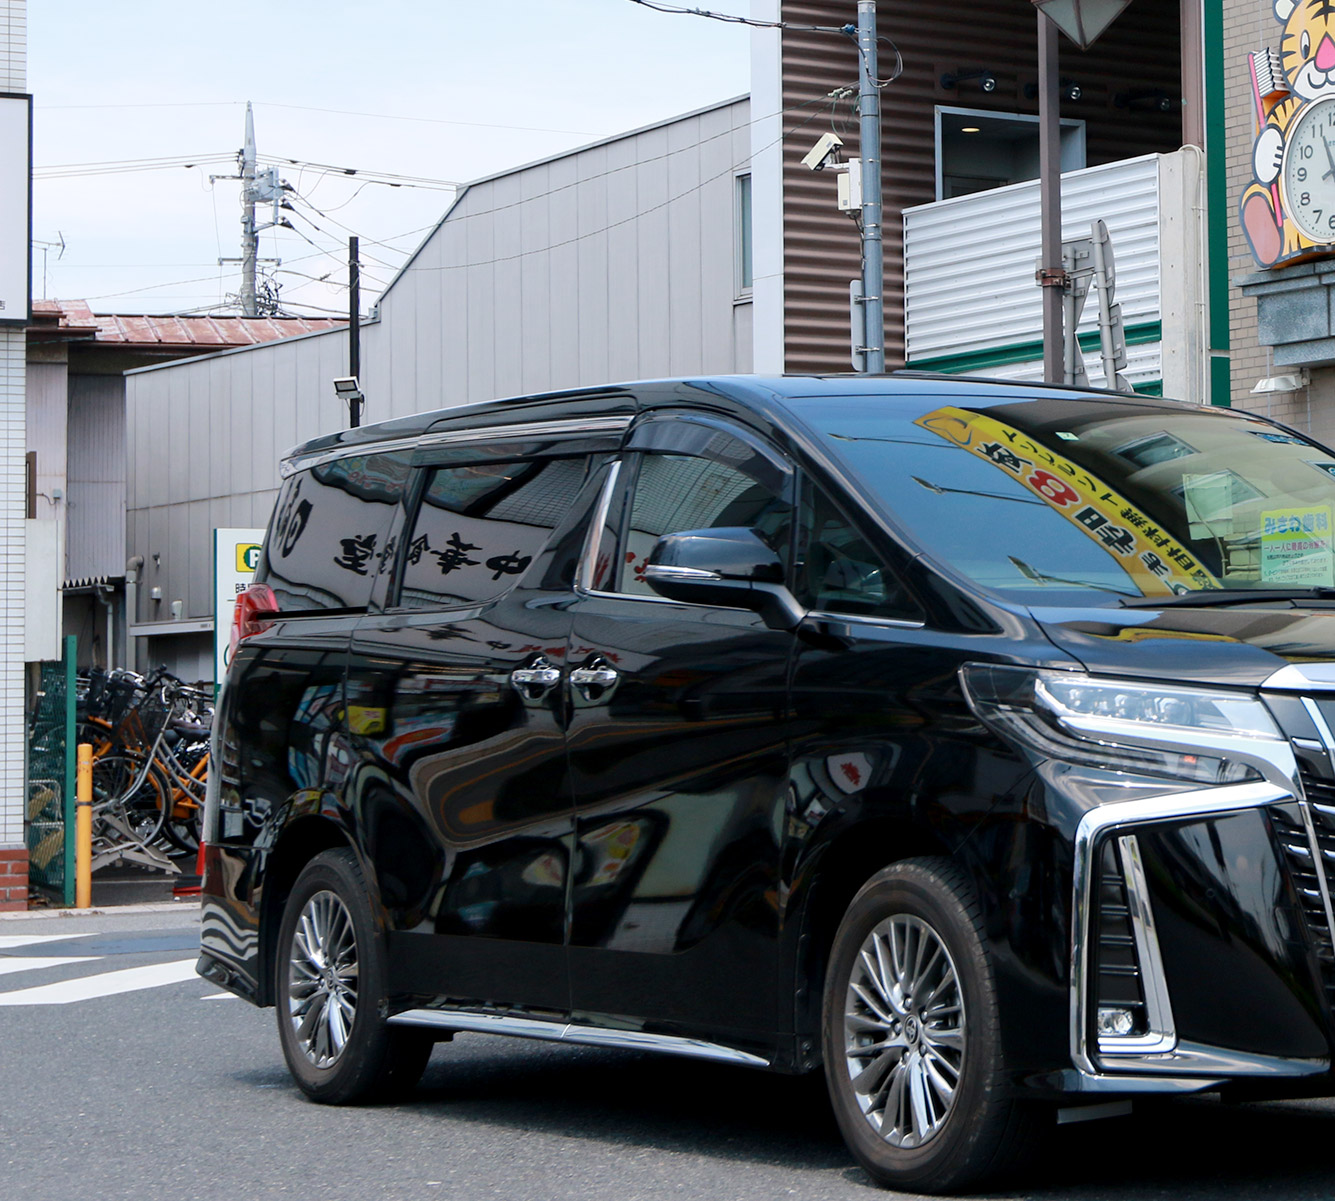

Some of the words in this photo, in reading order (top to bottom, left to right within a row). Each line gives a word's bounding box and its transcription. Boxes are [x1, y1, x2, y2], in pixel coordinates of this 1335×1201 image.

[1312, 124, 1324, 138] 11
[1300, 145, 1314, 160] 10
[1297, 167, 1307, 182] 9
[1300, 192, 1311, 206] 8
[1312, 210, 1323, 224] 7
